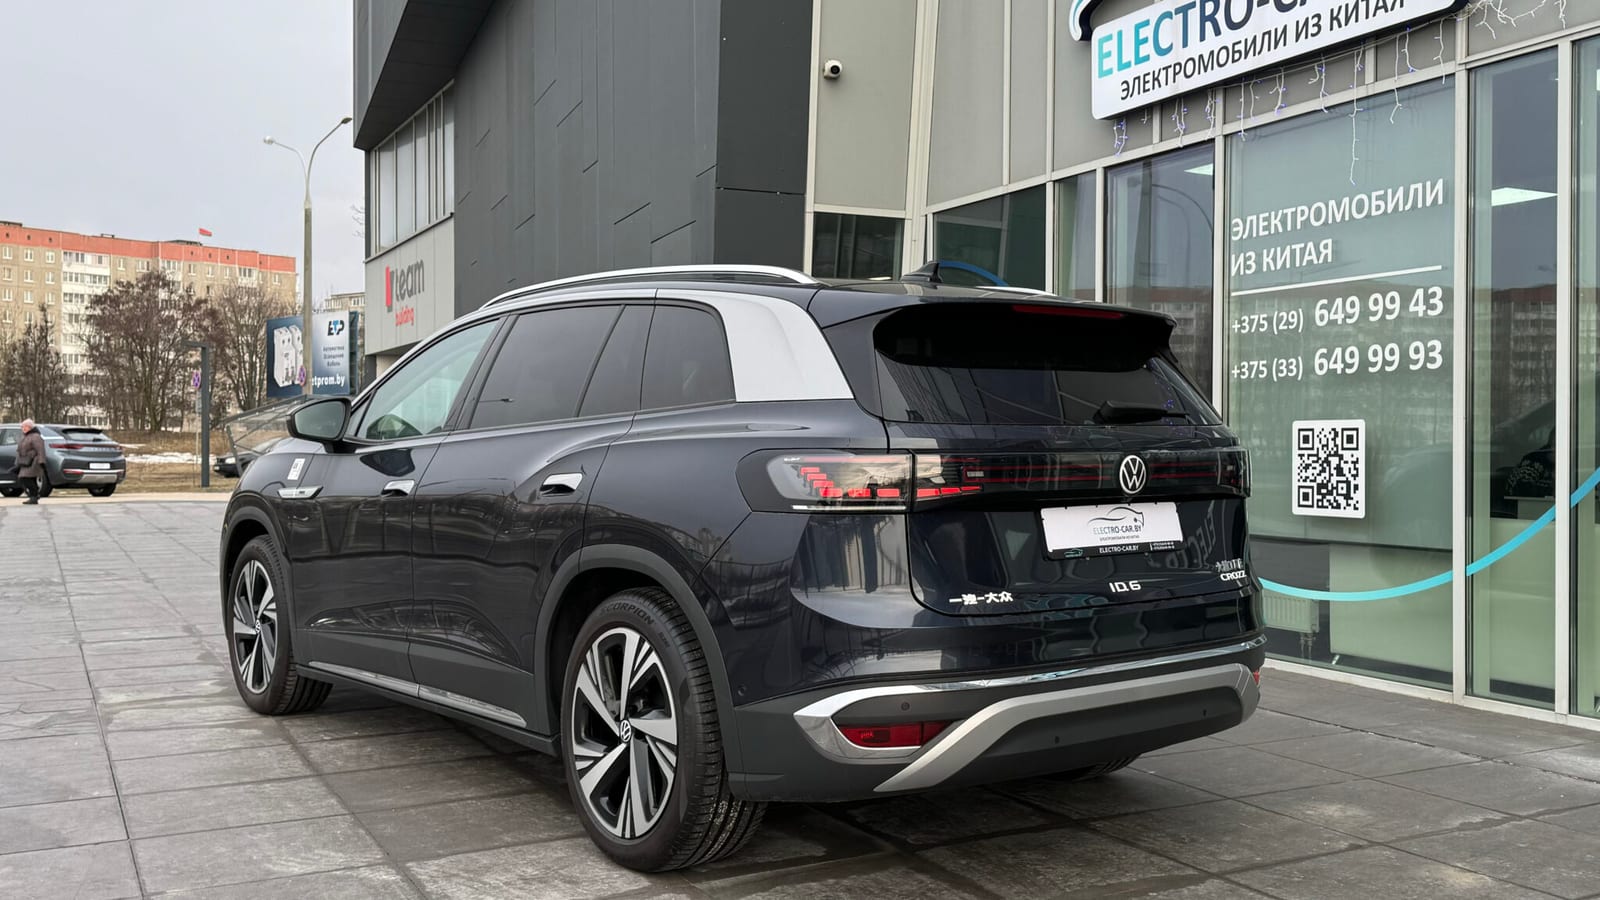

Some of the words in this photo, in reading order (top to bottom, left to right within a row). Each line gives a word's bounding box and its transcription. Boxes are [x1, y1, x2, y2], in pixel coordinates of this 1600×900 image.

[1097, 0, 1306, 79] ELECTRO-
[1120, 23, 1287, 101] ЭЛЕКТРОМОБИЛИ
[1295, 13, 1322, 43] ИЗ
[1231, 178, 1444, 241] ЭЛЕКТРОМОБИЛИ
[1231, 251, 1256, 276] ИЗ
[1262, 238, 1333, 272] КИТАЯ
[1231, 313, 1268, 334] +375
[1272, 308, 1304, 335] (29)
[1314, 295, 1360, 327] 649
[1368, 290, 1401, 322] 99
[1408, 286, 1444, 318] 43
[1231, 360, 1268, 380] +375
[1272, 356, 1304, 382] (33)
[1313, 345, 1360, 376] 649
[1367, 342, 1401, 373] 99
[1408, 339, 1443, 371] 93
[1092, 524, 1142, 536] ELECTRO-CAR.BY
